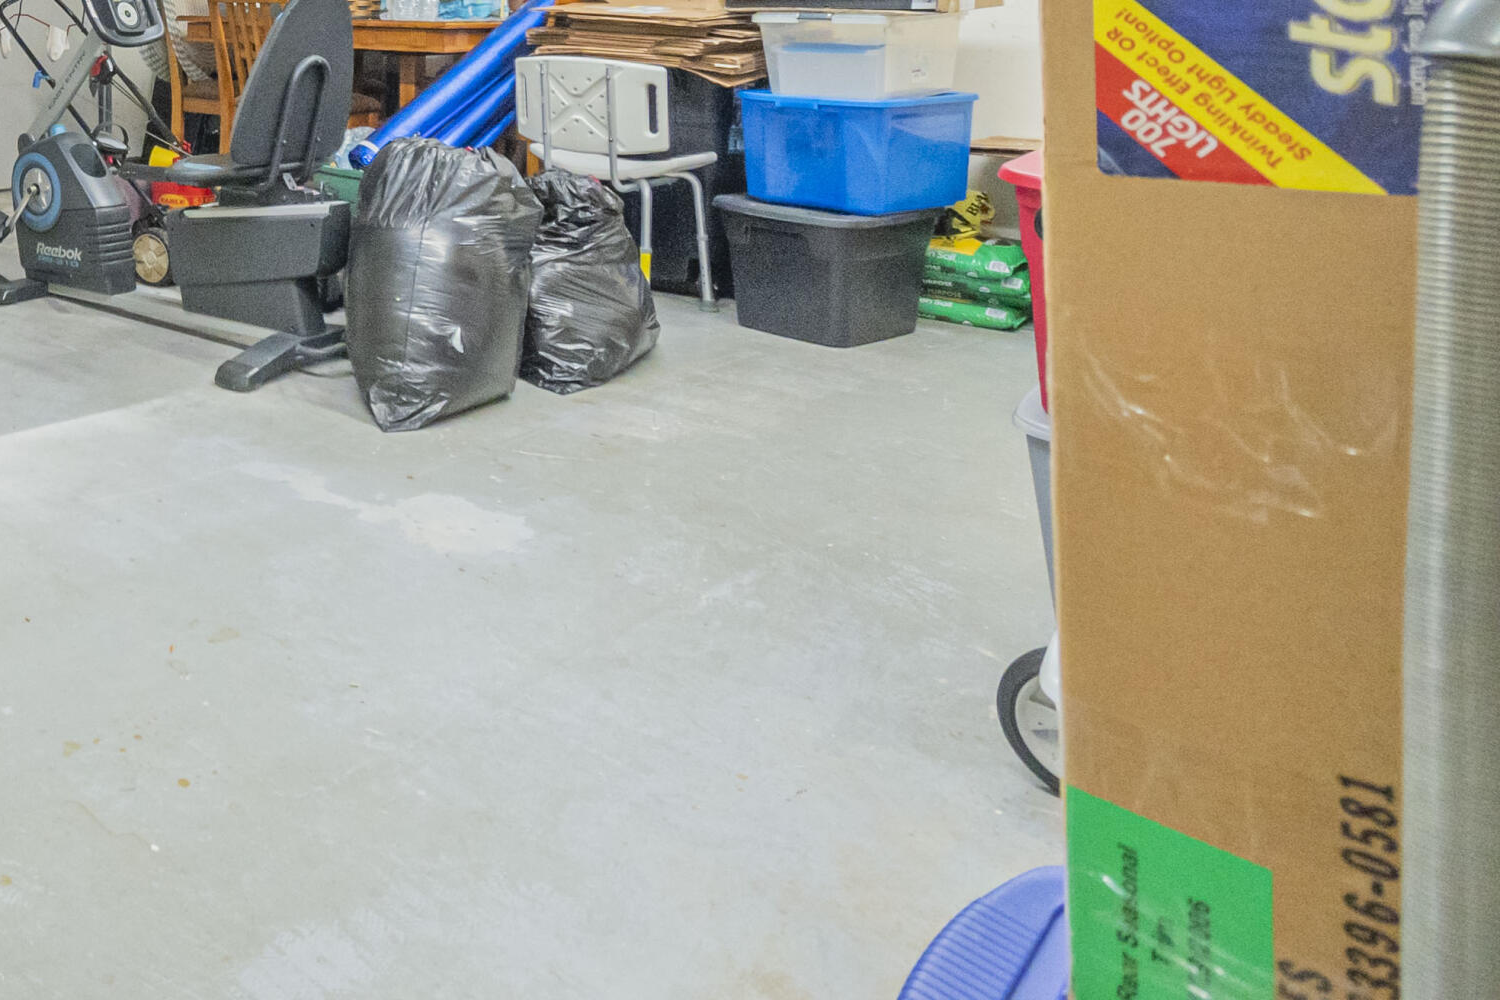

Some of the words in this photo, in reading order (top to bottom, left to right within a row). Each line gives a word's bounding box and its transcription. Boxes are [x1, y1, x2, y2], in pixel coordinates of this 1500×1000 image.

[1106, 26, 1136, 52] OR
[1115, 7, 1186, 64] Option!
[1136, 50, 1191, 96] Effect
[1186, 63, 1238, 105] Light
[1120, 107, 1177, 159] 700
[1121, 78, 1219, 160] LIGHTS
[1192, 91, 1284, 170] Twinkling
[1237, 100, 1313, 161] Steady
[36, 241, 83, 262] Reebok
[1337, 774, 1401, 1000] 3396-0581
